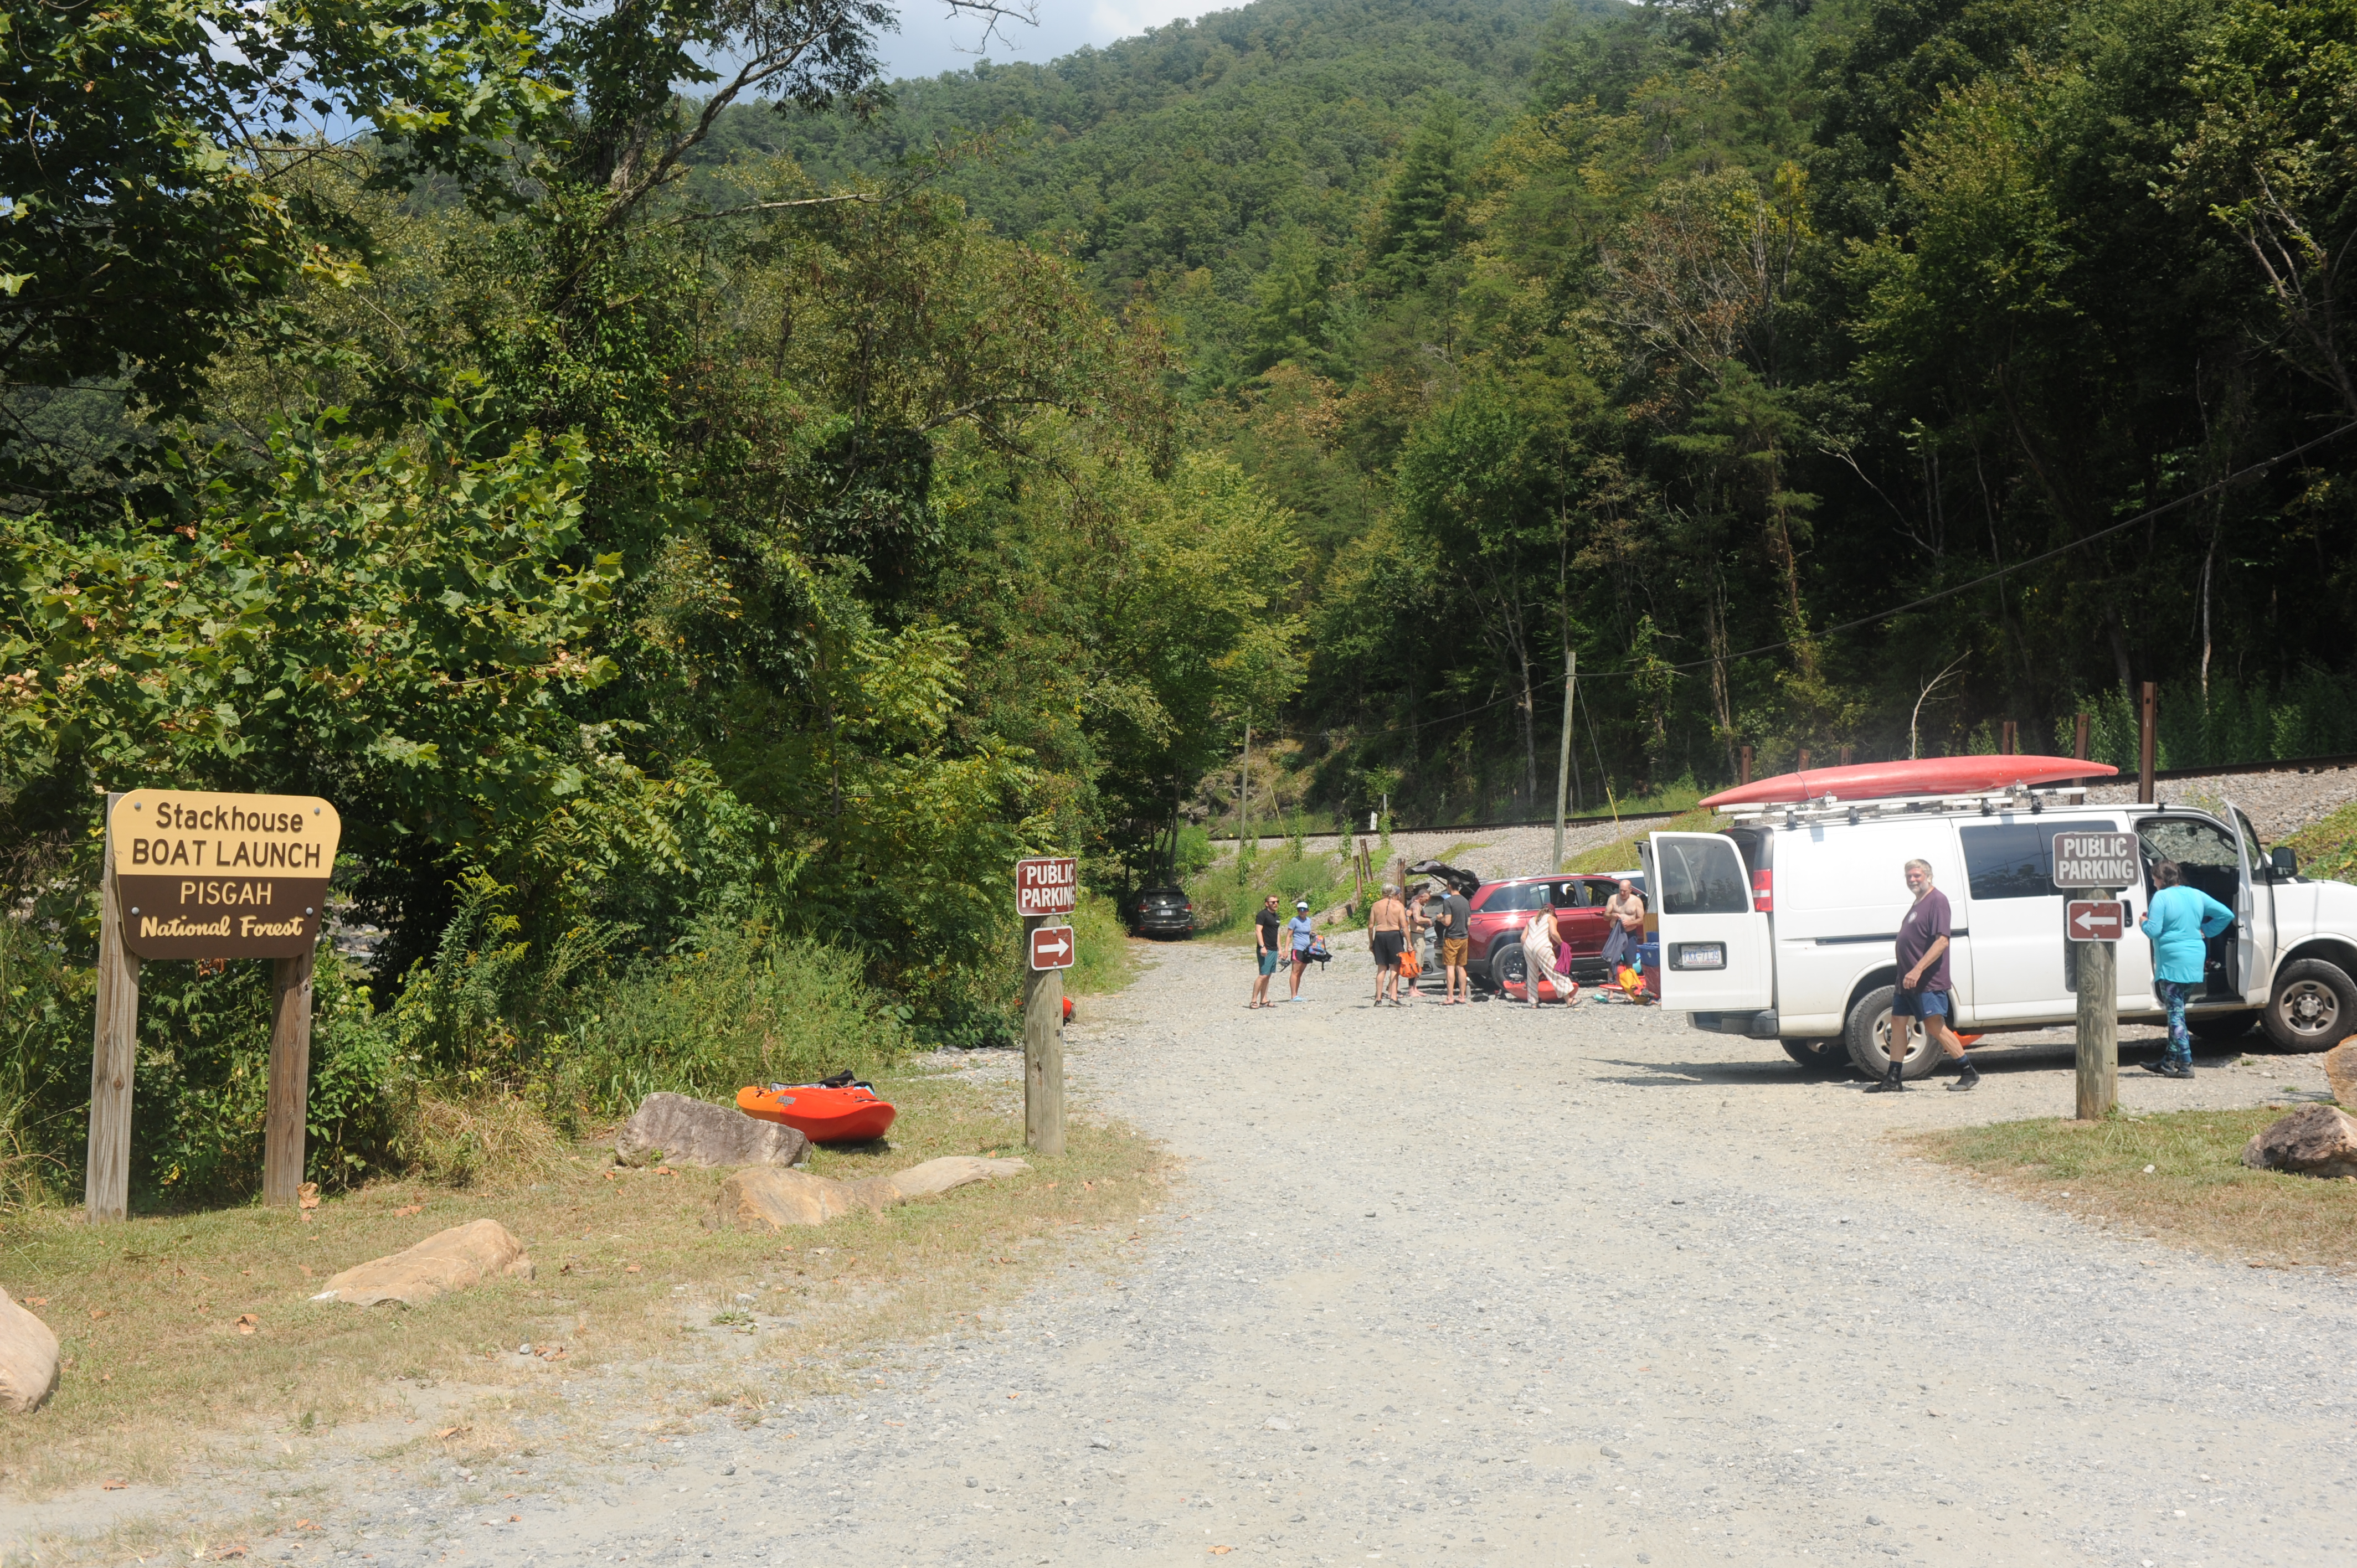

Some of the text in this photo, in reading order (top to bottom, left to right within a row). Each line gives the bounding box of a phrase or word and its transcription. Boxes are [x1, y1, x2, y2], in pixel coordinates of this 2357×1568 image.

[156, 802, 303, 833] Stackhouse
[132, 838, 321, 868] BOAT LAUNCH
[2063, 837, 2128, 858] PUBLIC
[1027, 863, 1074, 885] PUBLIC
[2058, 859, 2134, 880] PARKING
[180, 880, 272, 905] PISGAH
[1021, 885, 1075, 908] PARKING
[140, 914, 305, 938] National Forest
[1684, 950, 1720, 961] FKX-7139
